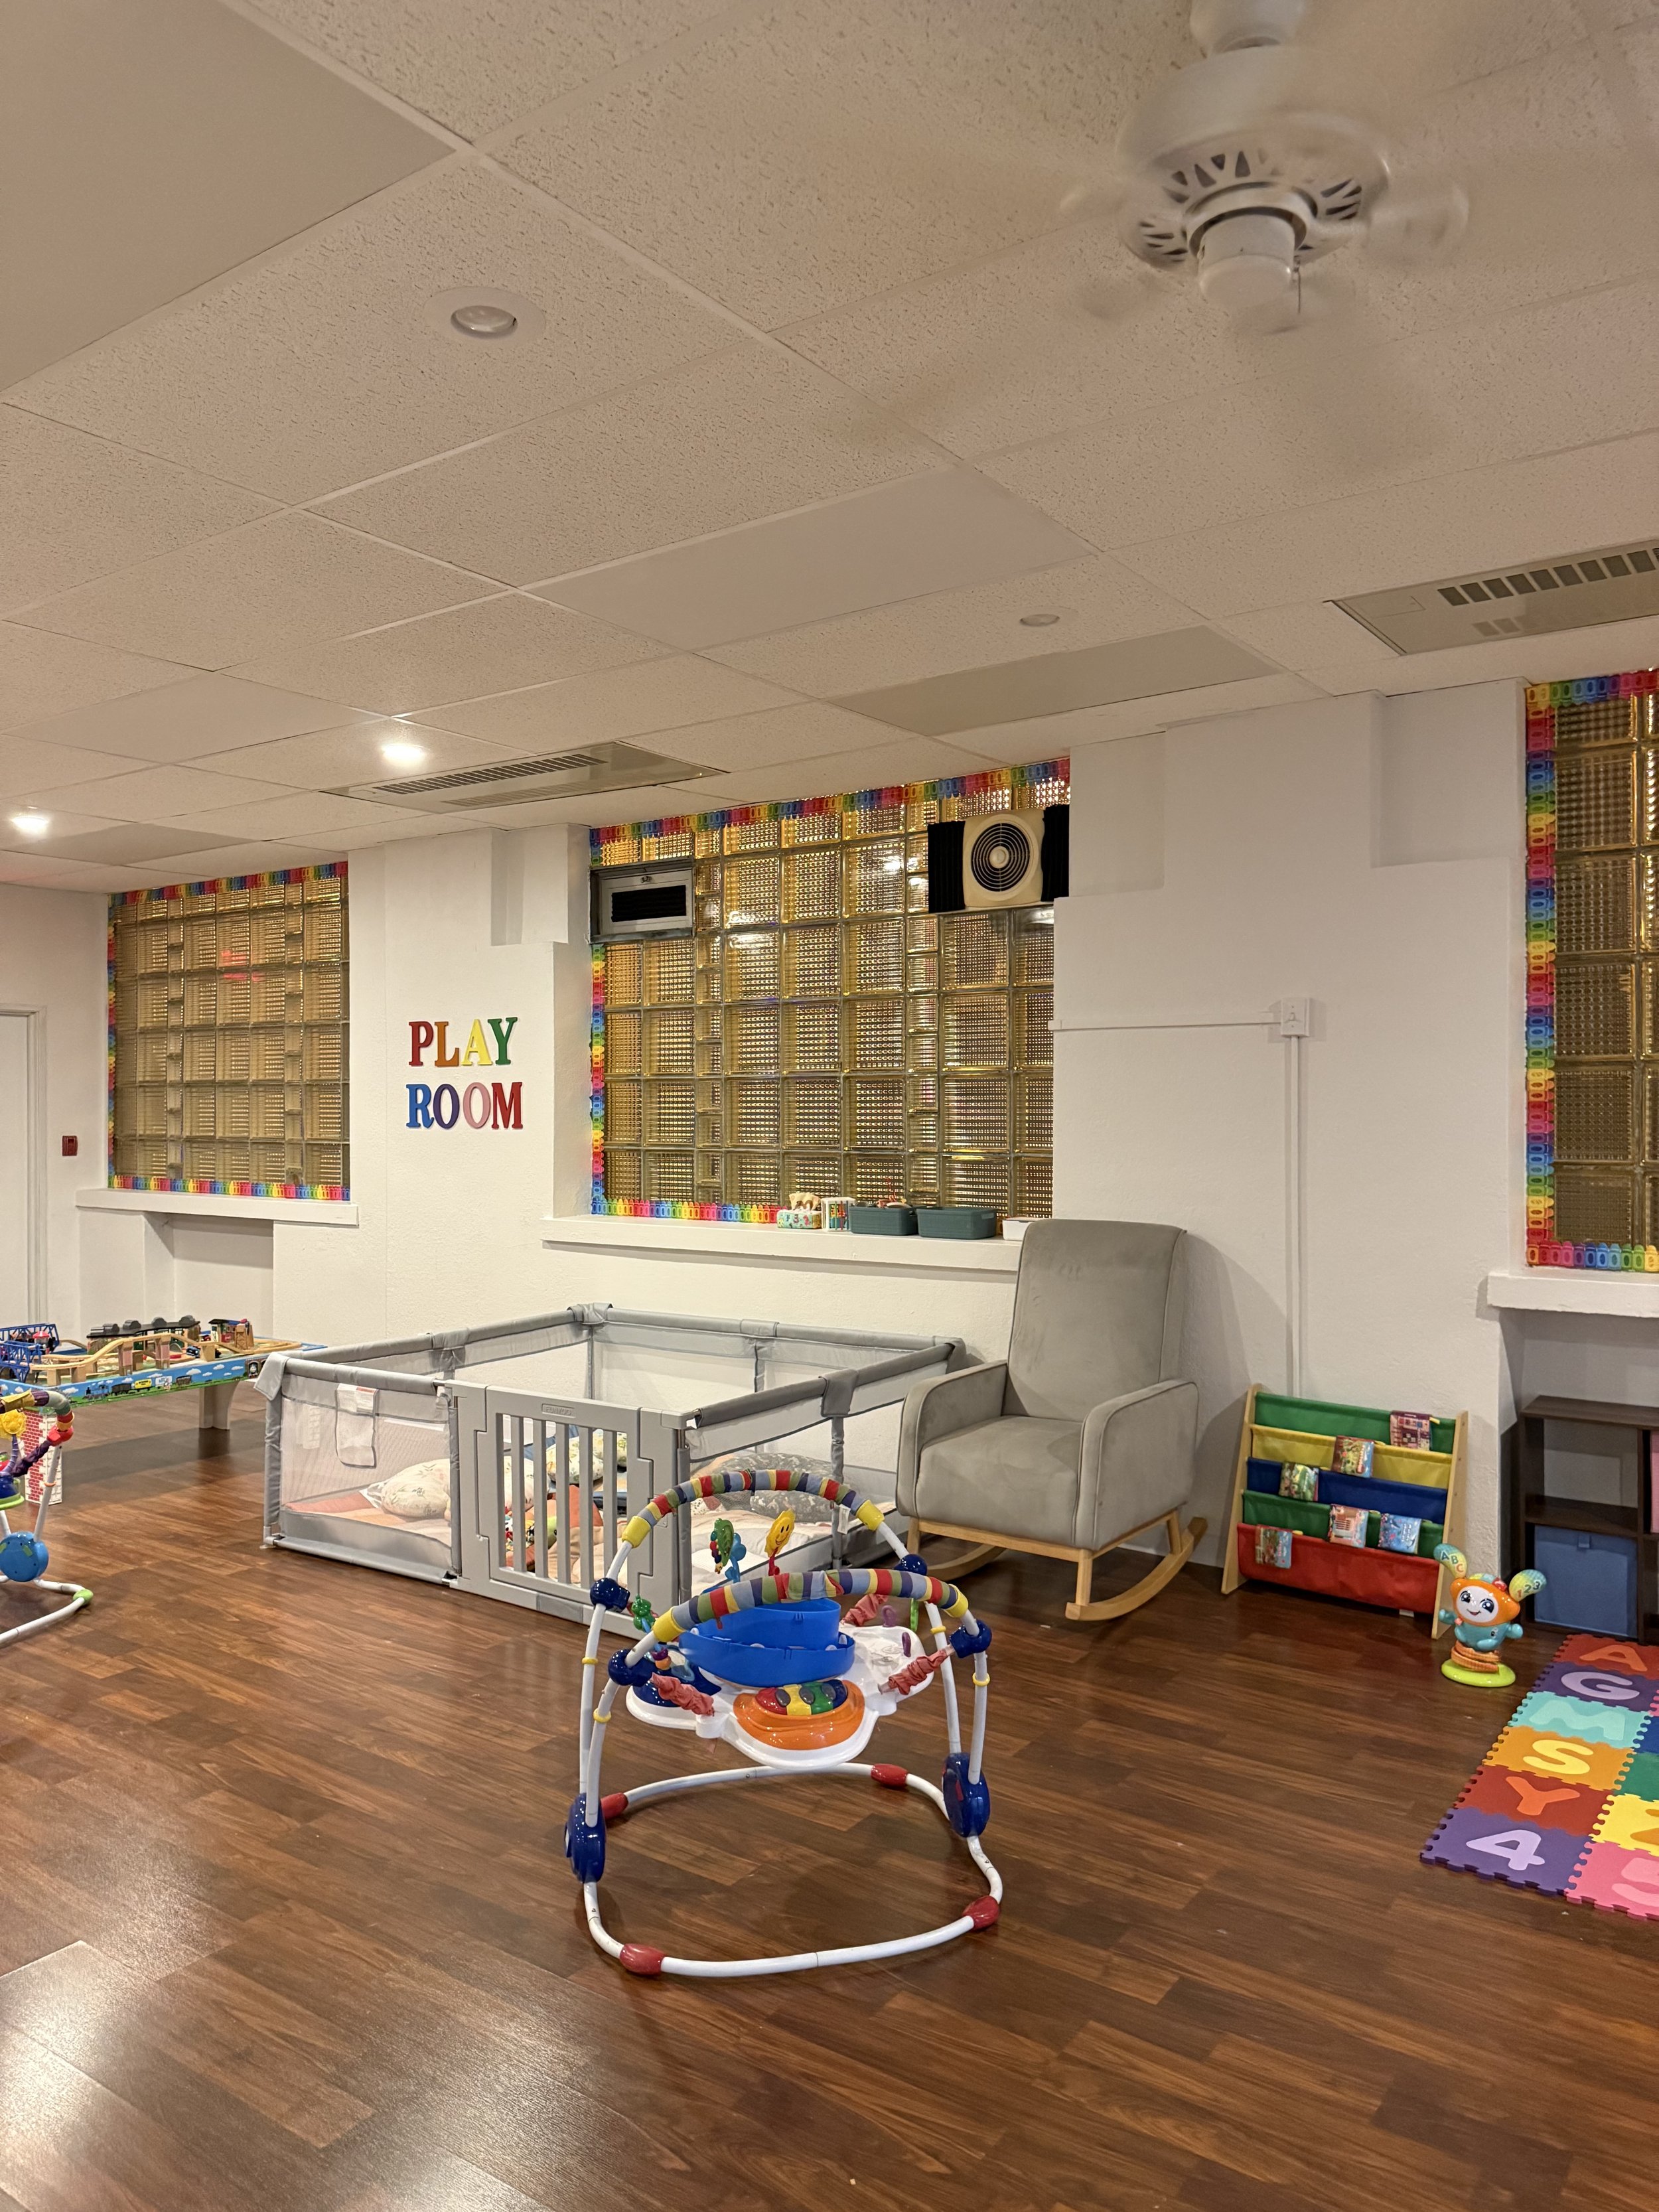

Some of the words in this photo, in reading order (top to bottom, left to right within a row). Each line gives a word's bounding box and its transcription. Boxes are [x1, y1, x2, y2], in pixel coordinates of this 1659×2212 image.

[408, 1017, 518, 1067] PLAY
[405, 1082, 523, 1130] ROOM
[1579, 1645, 1648, 1672] A
[1561, 1671, 1640, 1700] G
[1522, 1739, 1594, 1775] S
[1505, 1776, 1581, 1816] Y
[1466, 1829, 1546, 1871] 4
